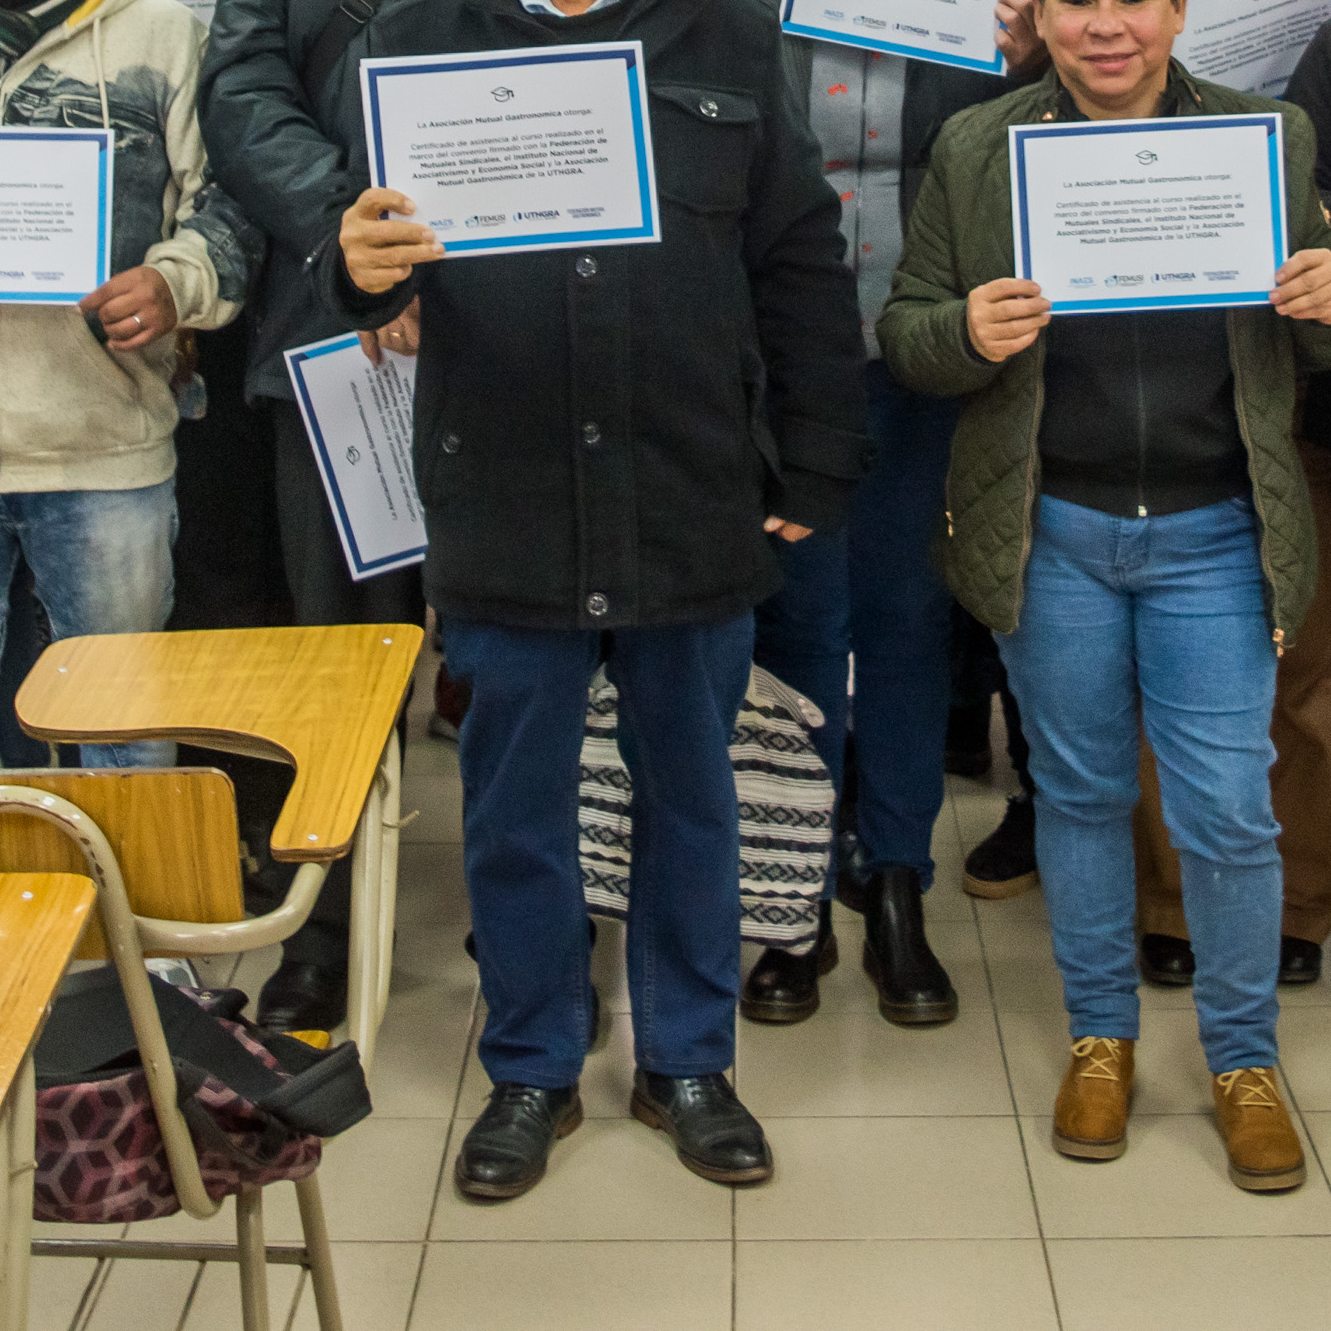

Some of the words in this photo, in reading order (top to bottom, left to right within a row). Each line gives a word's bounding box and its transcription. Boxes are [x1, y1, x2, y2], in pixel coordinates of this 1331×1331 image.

[429, 118, 473, 127] Asociación
[410, 141, 454, 150] Certificado
[469, 137, 509, 145] asistencia
[545, 130, 582, 138] realizado
[489, 145, 521, 153] firmado
[549, 138, 595, 147] Federación
[412, 169, 469, 179] Asociativismo
[564, 156, 608, 165] Asociación
[420, 160, 456, 169] Mutuales
[513, 152, 547, 160] Instituto
[550, 149, 585, 157] Nacional
[524, 210, 560, 219] UTHGRA
